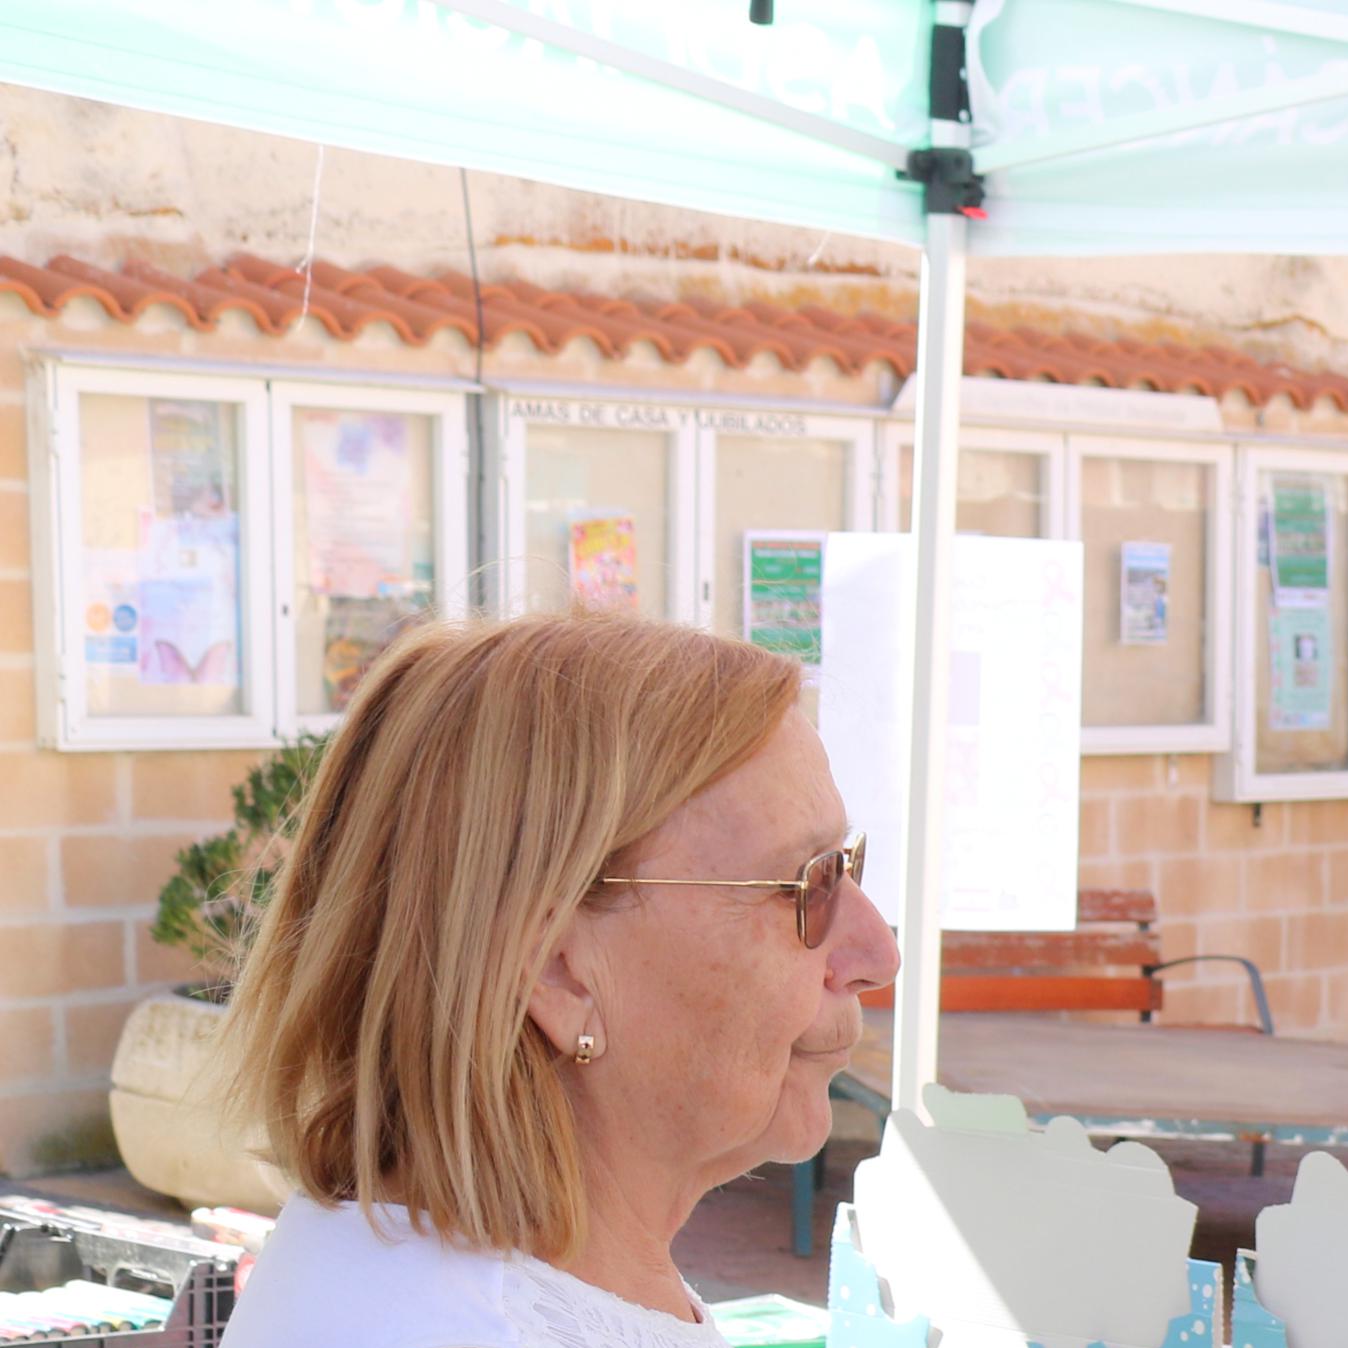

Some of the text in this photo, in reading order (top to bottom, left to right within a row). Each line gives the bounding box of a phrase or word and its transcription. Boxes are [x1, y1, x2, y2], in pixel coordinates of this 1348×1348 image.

[512, 402, 569, 424] AMAS
[579, 405, 601, 425] DE
[615, 407, 670, 428] CASA
